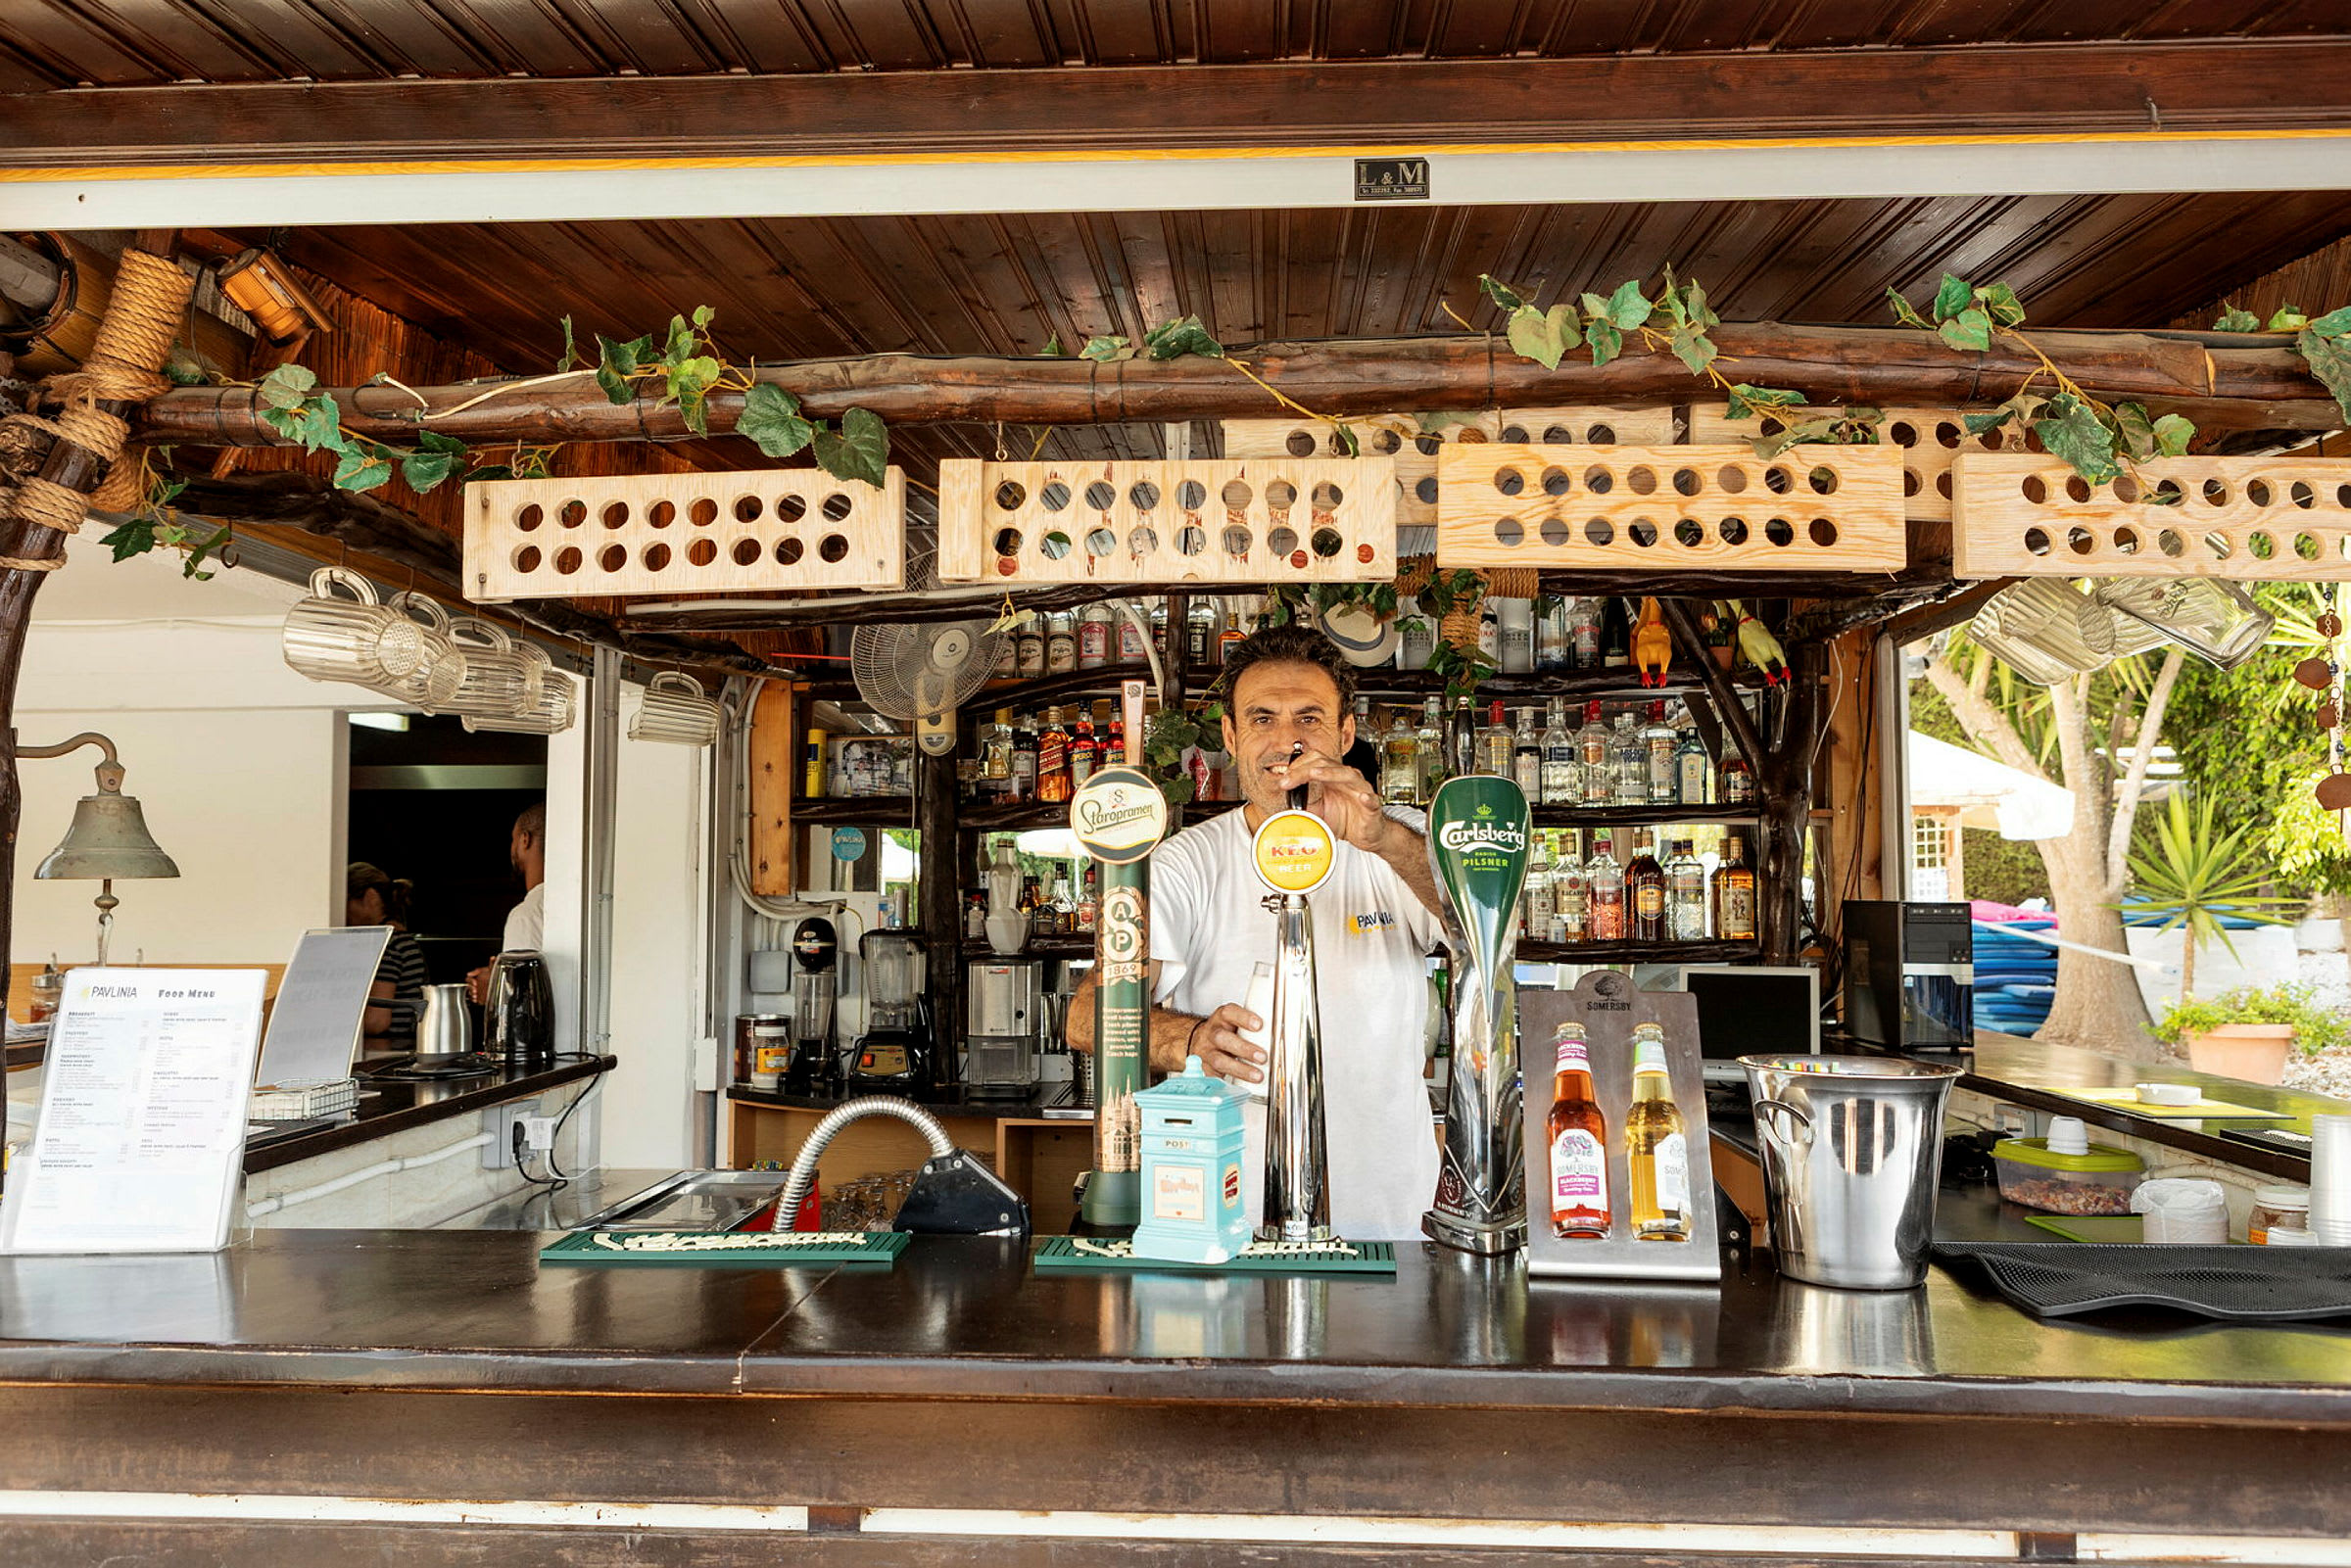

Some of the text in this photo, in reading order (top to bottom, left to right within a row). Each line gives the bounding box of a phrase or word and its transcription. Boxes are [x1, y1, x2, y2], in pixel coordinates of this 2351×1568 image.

[1359, 162, 1426, 185] L & M
[1080, 800, 1155, 834] Staropramen
[1440, 821, 1525, 853] Carlsberg
[1271, 846, 1317, 858] KEO
[1278, 863, 1312, 873] BEER
[1463, 858, 1510, 868] PILSNER
[1108, 964, 1137, 975] 1869
[91, 986, 138, 999] PAVLINIA
[1587, 1000, 1632, 1012] SOMERSBY
[1165, 1139, 1189, 1149] POST
